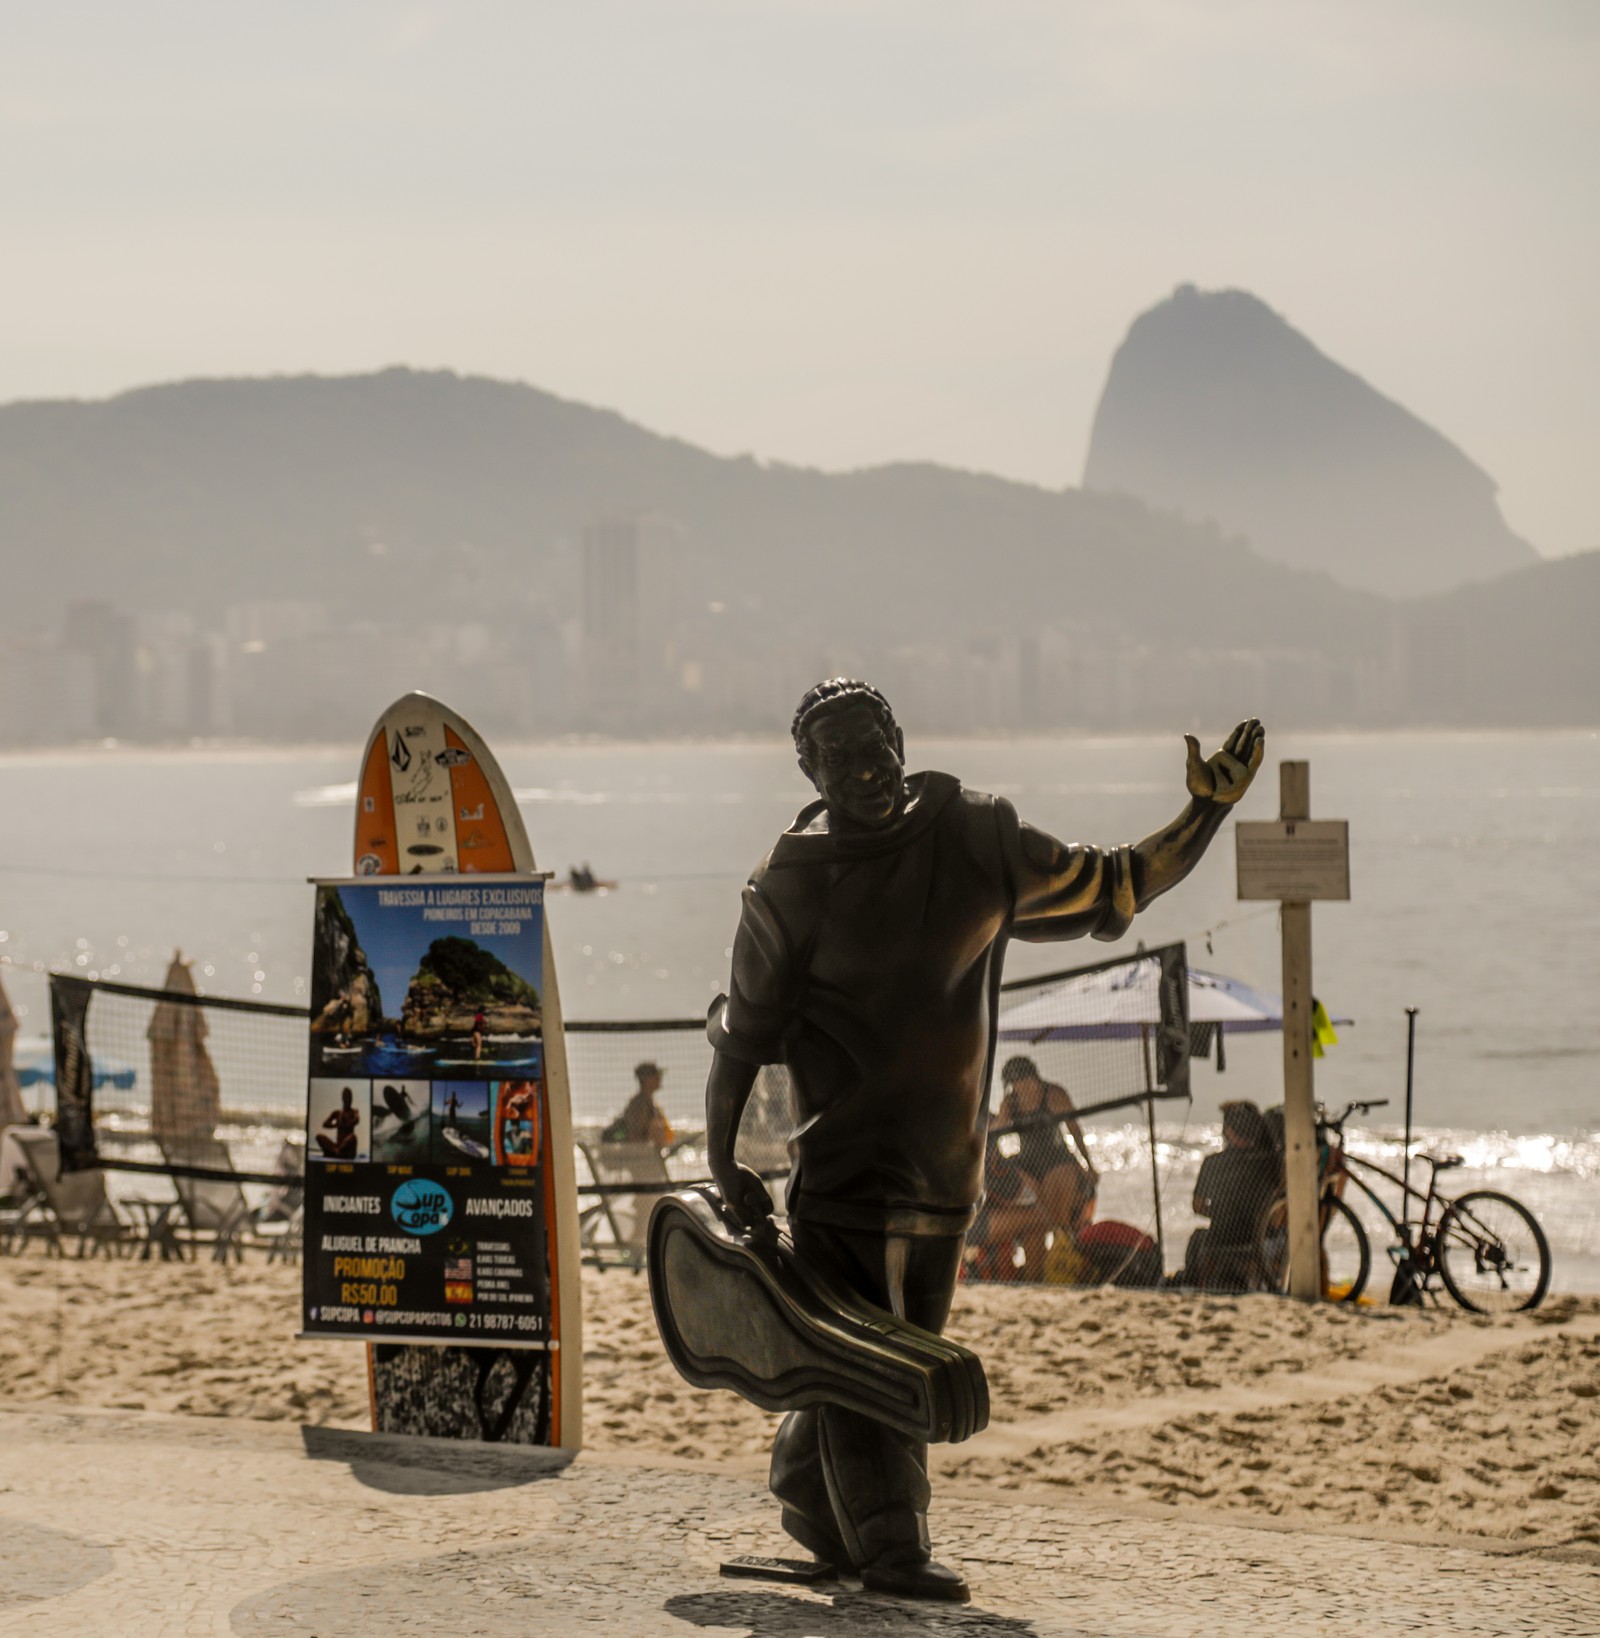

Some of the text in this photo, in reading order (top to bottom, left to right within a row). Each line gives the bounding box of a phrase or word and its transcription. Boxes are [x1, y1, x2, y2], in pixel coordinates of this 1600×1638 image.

[378, 888, 543, 906] TRAVESSIA A LUGARES EXCLUSIVOS
[465, 908, 477, 920] EM
[479, 907, 532, 920] COPACABANA
[323, 1195, 381, 1214] INICIANTES
[466, 1198, 533, 1219] AVANÇADOS
[365, 1236, 378, 1253] DE
[379, 1236, 422, 1254] PRANCHA
[334, 1255, 405, 1283] PROMOÇÃO
[341, 1283, 397, 1306] R$50,00
[469, 1314, 481, 1328] 21
